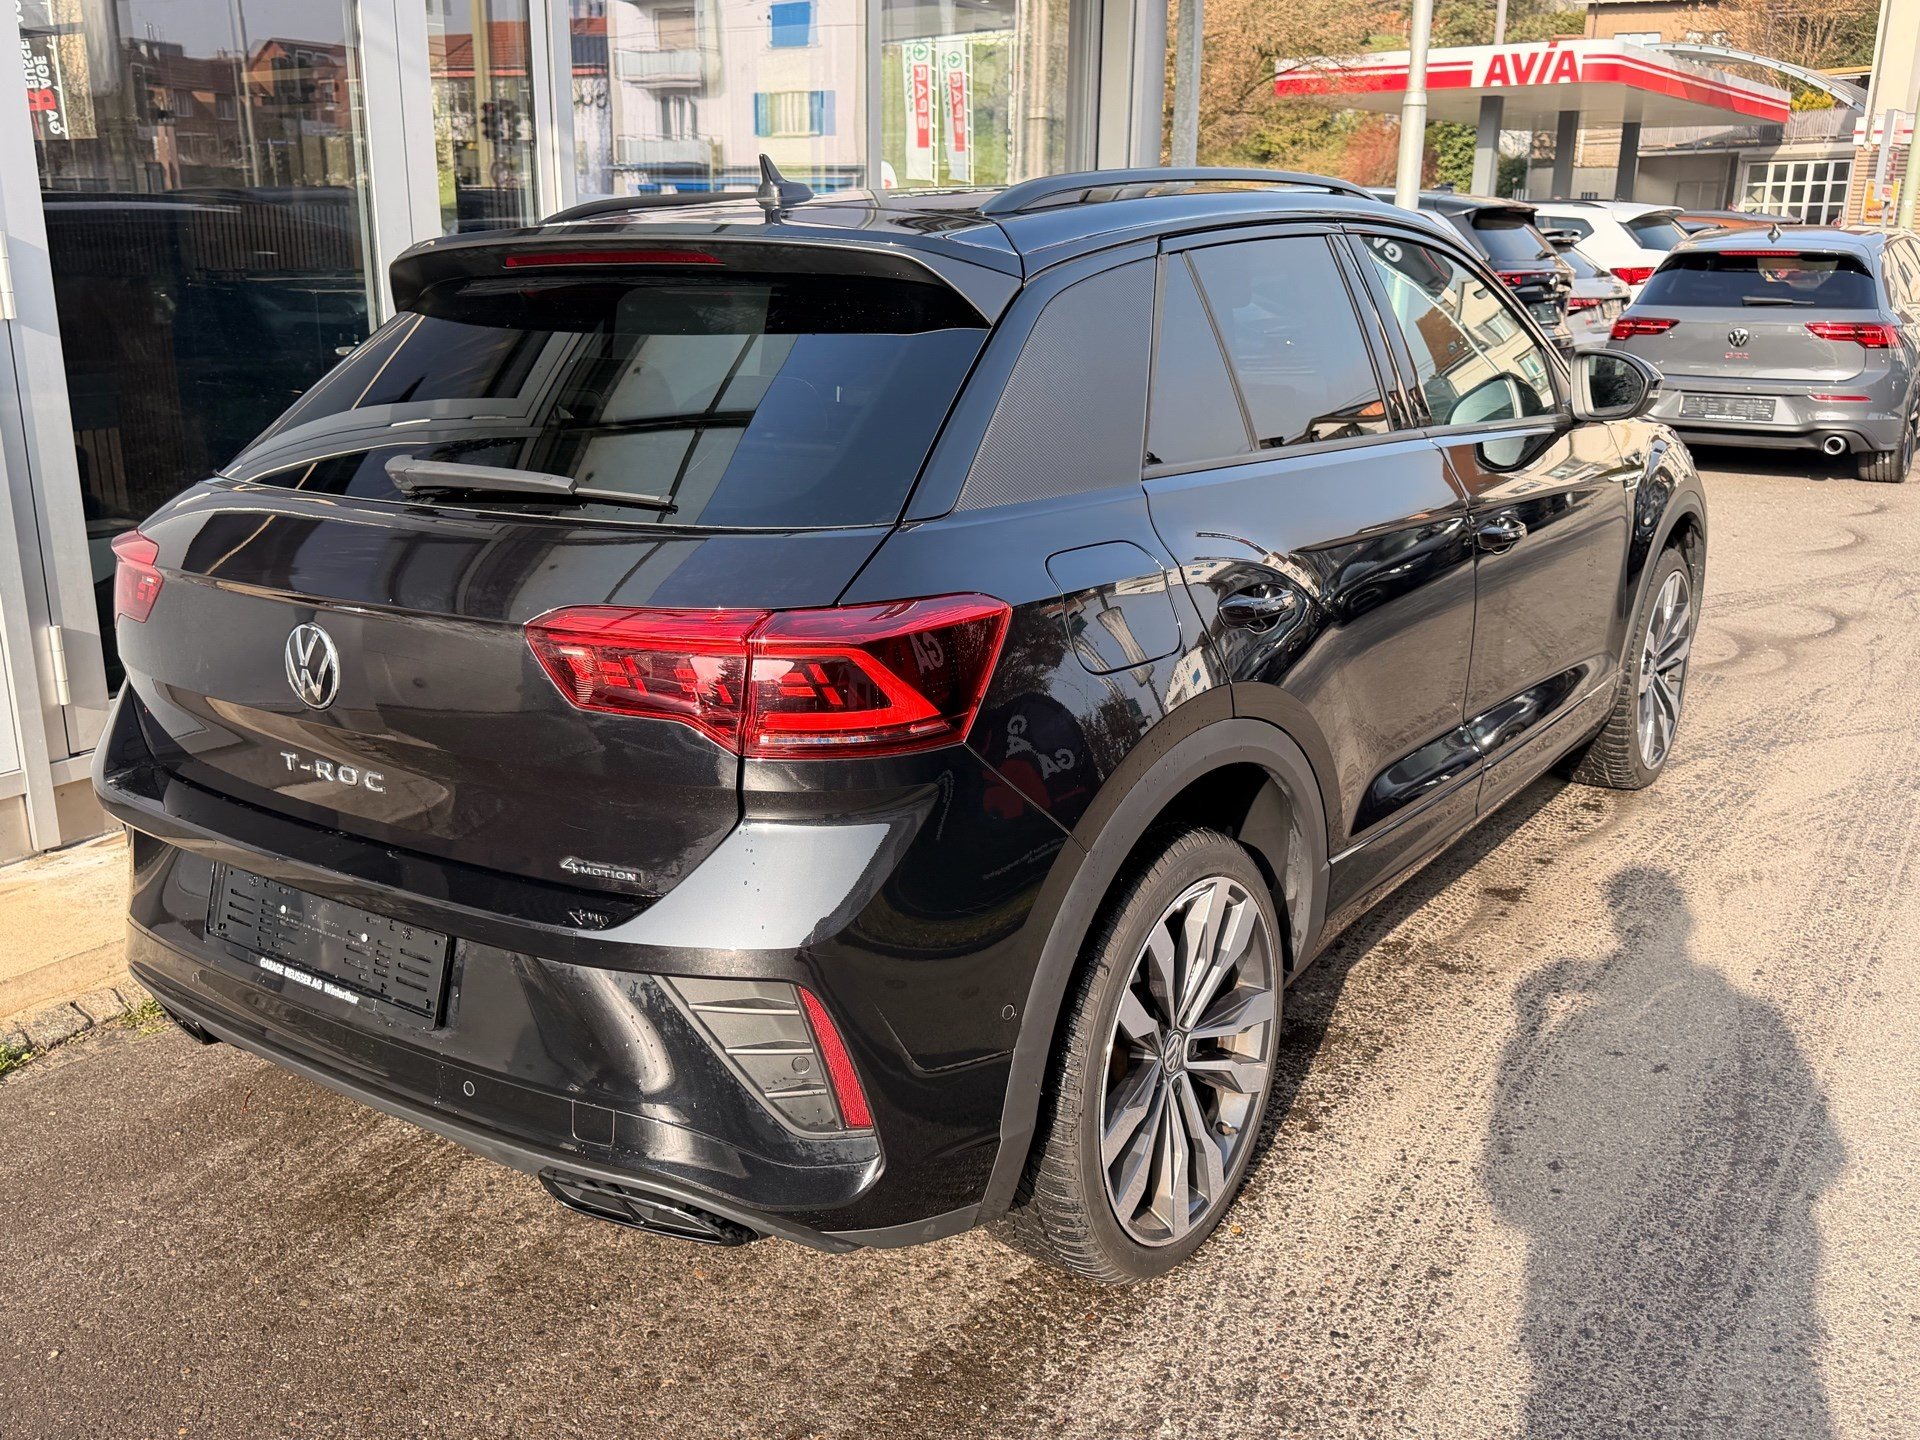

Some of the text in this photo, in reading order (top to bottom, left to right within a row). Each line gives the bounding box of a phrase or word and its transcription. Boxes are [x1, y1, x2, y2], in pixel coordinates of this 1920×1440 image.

[1483, 41, 1579, 88] AVIA
[280, 751, 387, 794] T-ROC
[560, 858, 636, 881] 4MOTION
[260, 957, 284, 976] GARAGE
[312, 978, 323, 991] AG
[324, 982, 359, 1005] Winterthur
